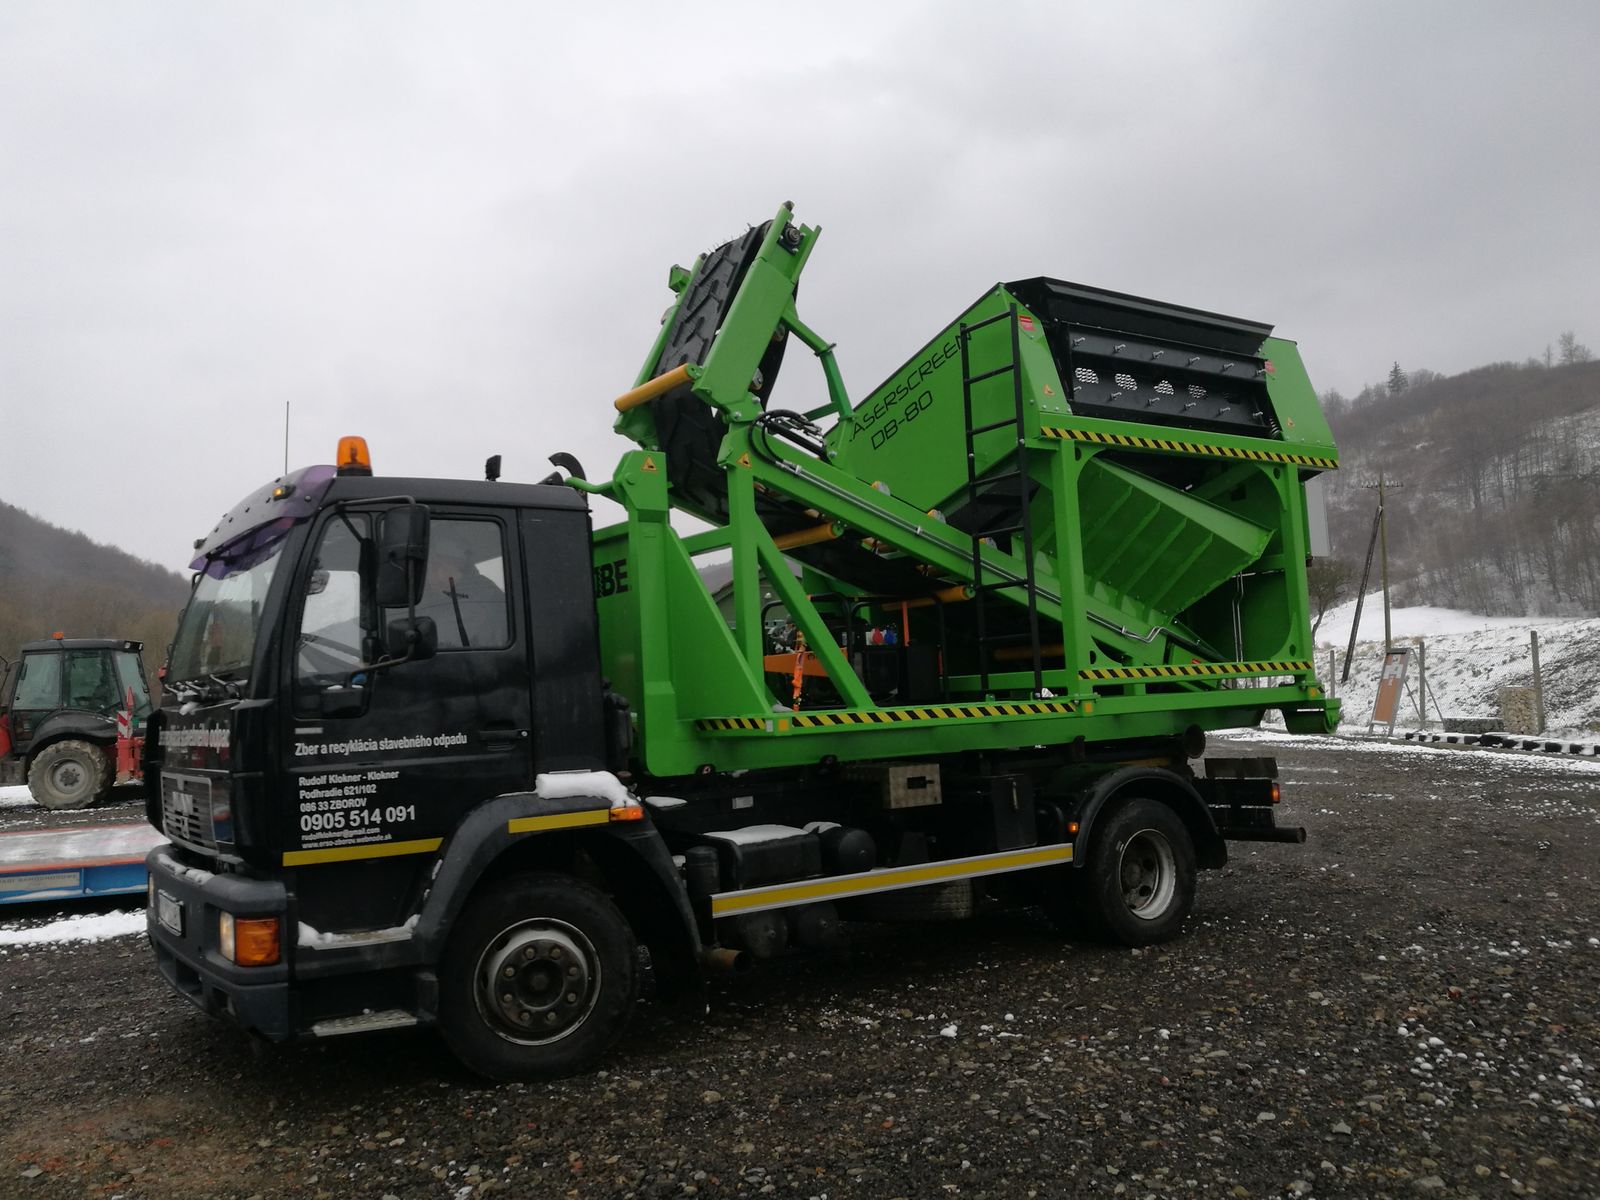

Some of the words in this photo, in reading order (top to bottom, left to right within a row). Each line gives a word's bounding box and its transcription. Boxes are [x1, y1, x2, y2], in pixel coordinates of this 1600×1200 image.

[871, 390, 934, 450] DB-80
[295, 742, 318, 756] Zber
[321, 745, 328, 754] a
[329, 738, 378, 755] recyklácia
[379, 734, 432, 750] stavebného
[433, 732, 468, 748] odpadu
[299, 776, 327, 786] Rudolf
[330, 773, 362, 784] Klokner
[368, 771, 400, 781] Klokner
[299, 788, 342, 799] Podhradie
[318, 801, 329, 811] 33
[329, 798, 367, 810] ZBOROV
[300, 811, 345, 831] 0905
[349, 808, 382, 827] 514
[385, 805, 416, 822] 091
